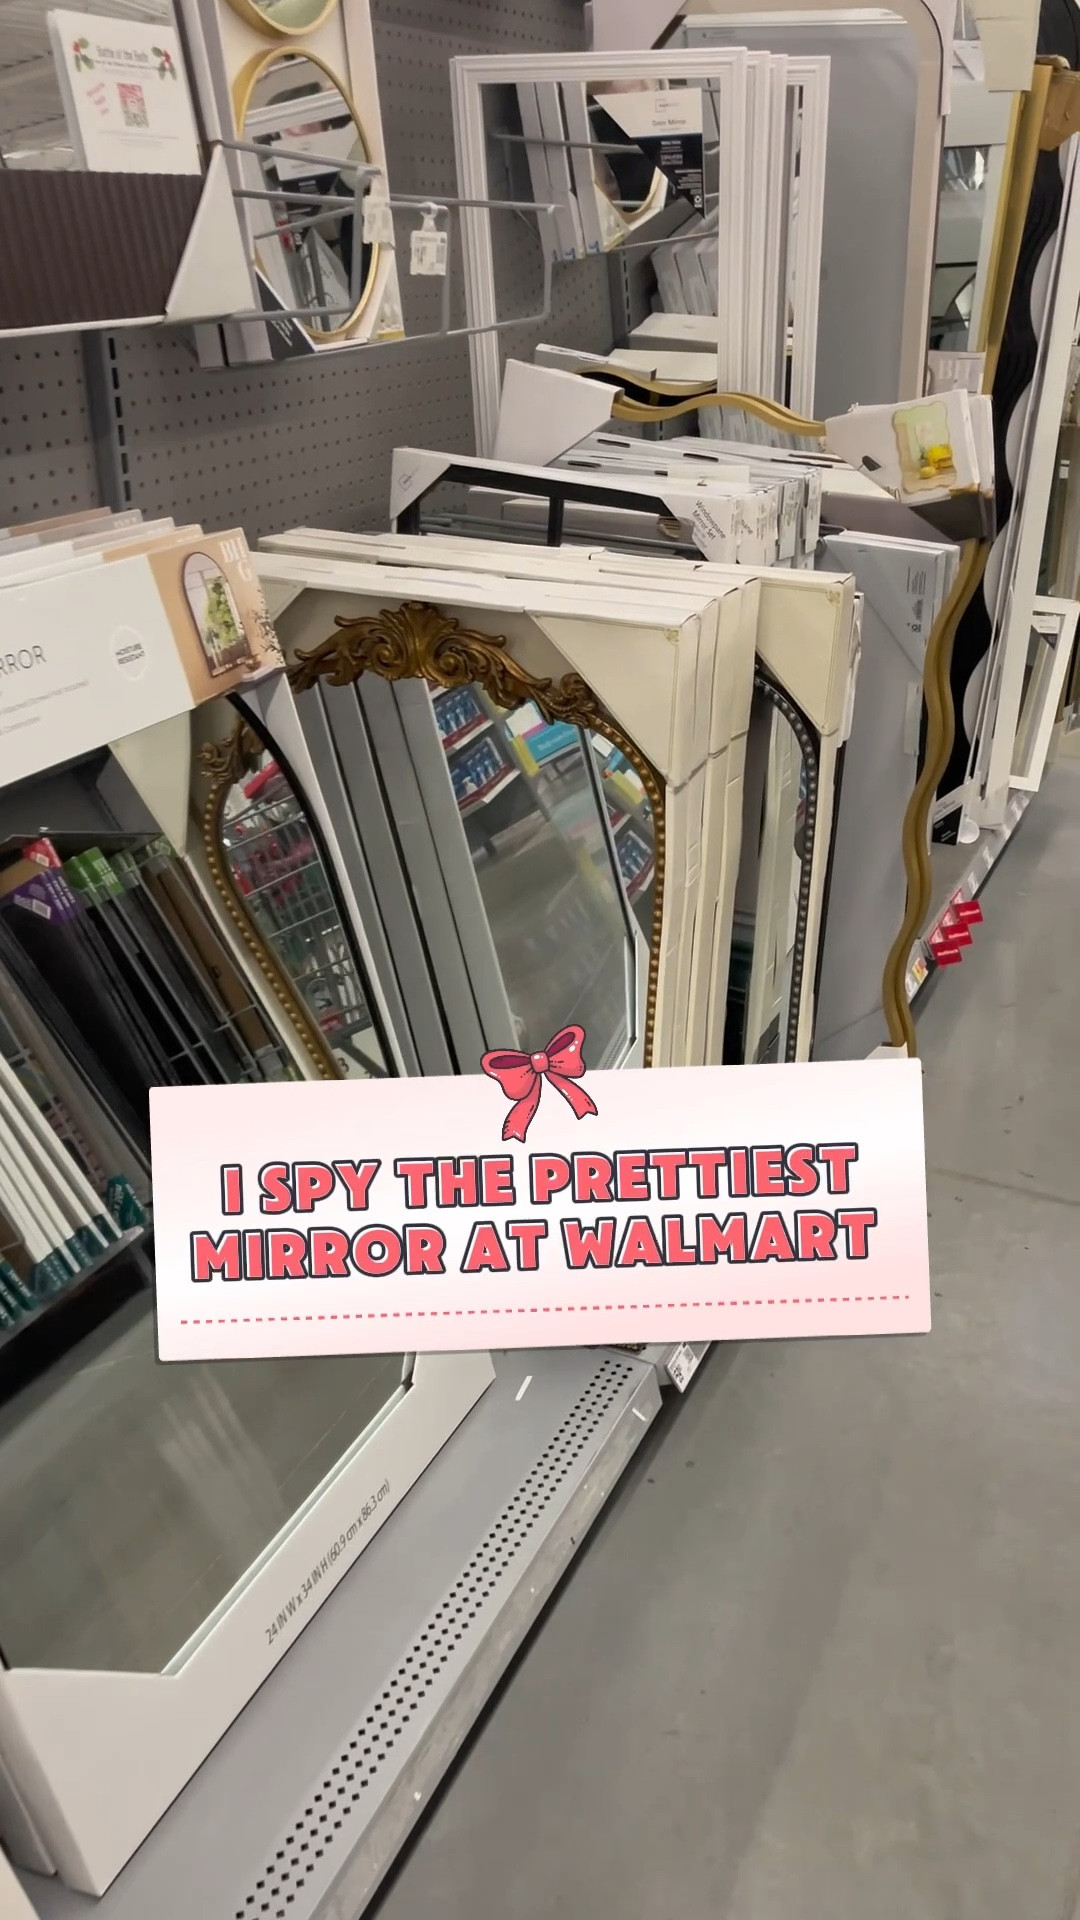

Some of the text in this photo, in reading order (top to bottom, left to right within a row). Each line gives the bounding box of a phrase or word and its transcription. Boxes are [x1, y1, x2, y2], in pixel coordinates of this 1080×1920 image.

[692, 509, 708, 531] Mirror
[706, 529, 717, 541] Set
[696, 500, 726, 538] Windowpane
[265, 1623, 278, 1645] 24
[276, 1611, 287, 1630] IN
[285, 1597, 296, 1616] W
[296, 1594, 303, 1607] x
[301, 1578, 313, 1598] 34
[310, 1564, 322, 1583] IN
[320, 1557, 329, 1574] H
[327, 1534, 347, 1566] (60.9
[347, 1522, 358, 1541] cm
[361, 1495, 378, 1521] 86.3
[377, 1478, 391, 1502] cm)
